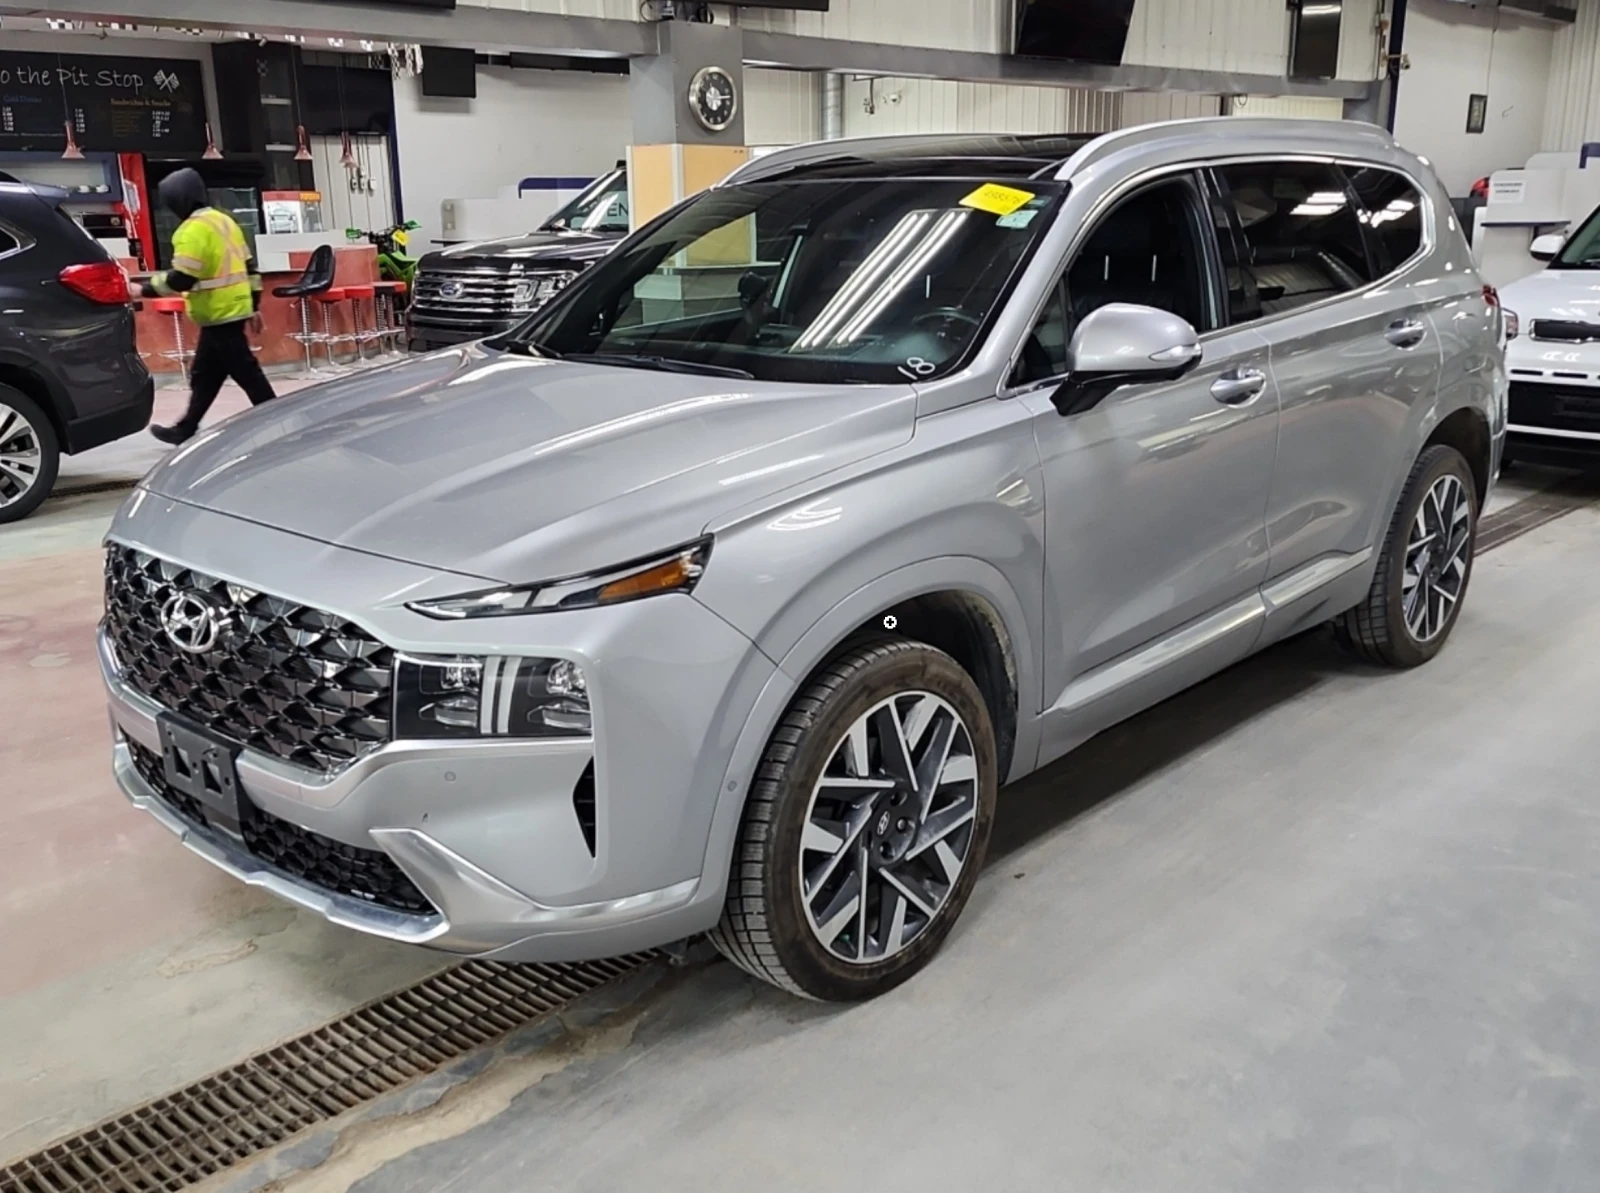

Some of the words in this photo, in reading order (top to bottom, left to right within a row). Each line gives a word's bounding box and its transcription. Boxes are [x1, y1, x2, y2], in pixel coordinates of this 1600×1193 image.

[17, 66, 50, 86] the
[56, 67, 90, 86] Pit
[95, 69, 143, 95] Stop
[897, 357, 936, 380] 18
